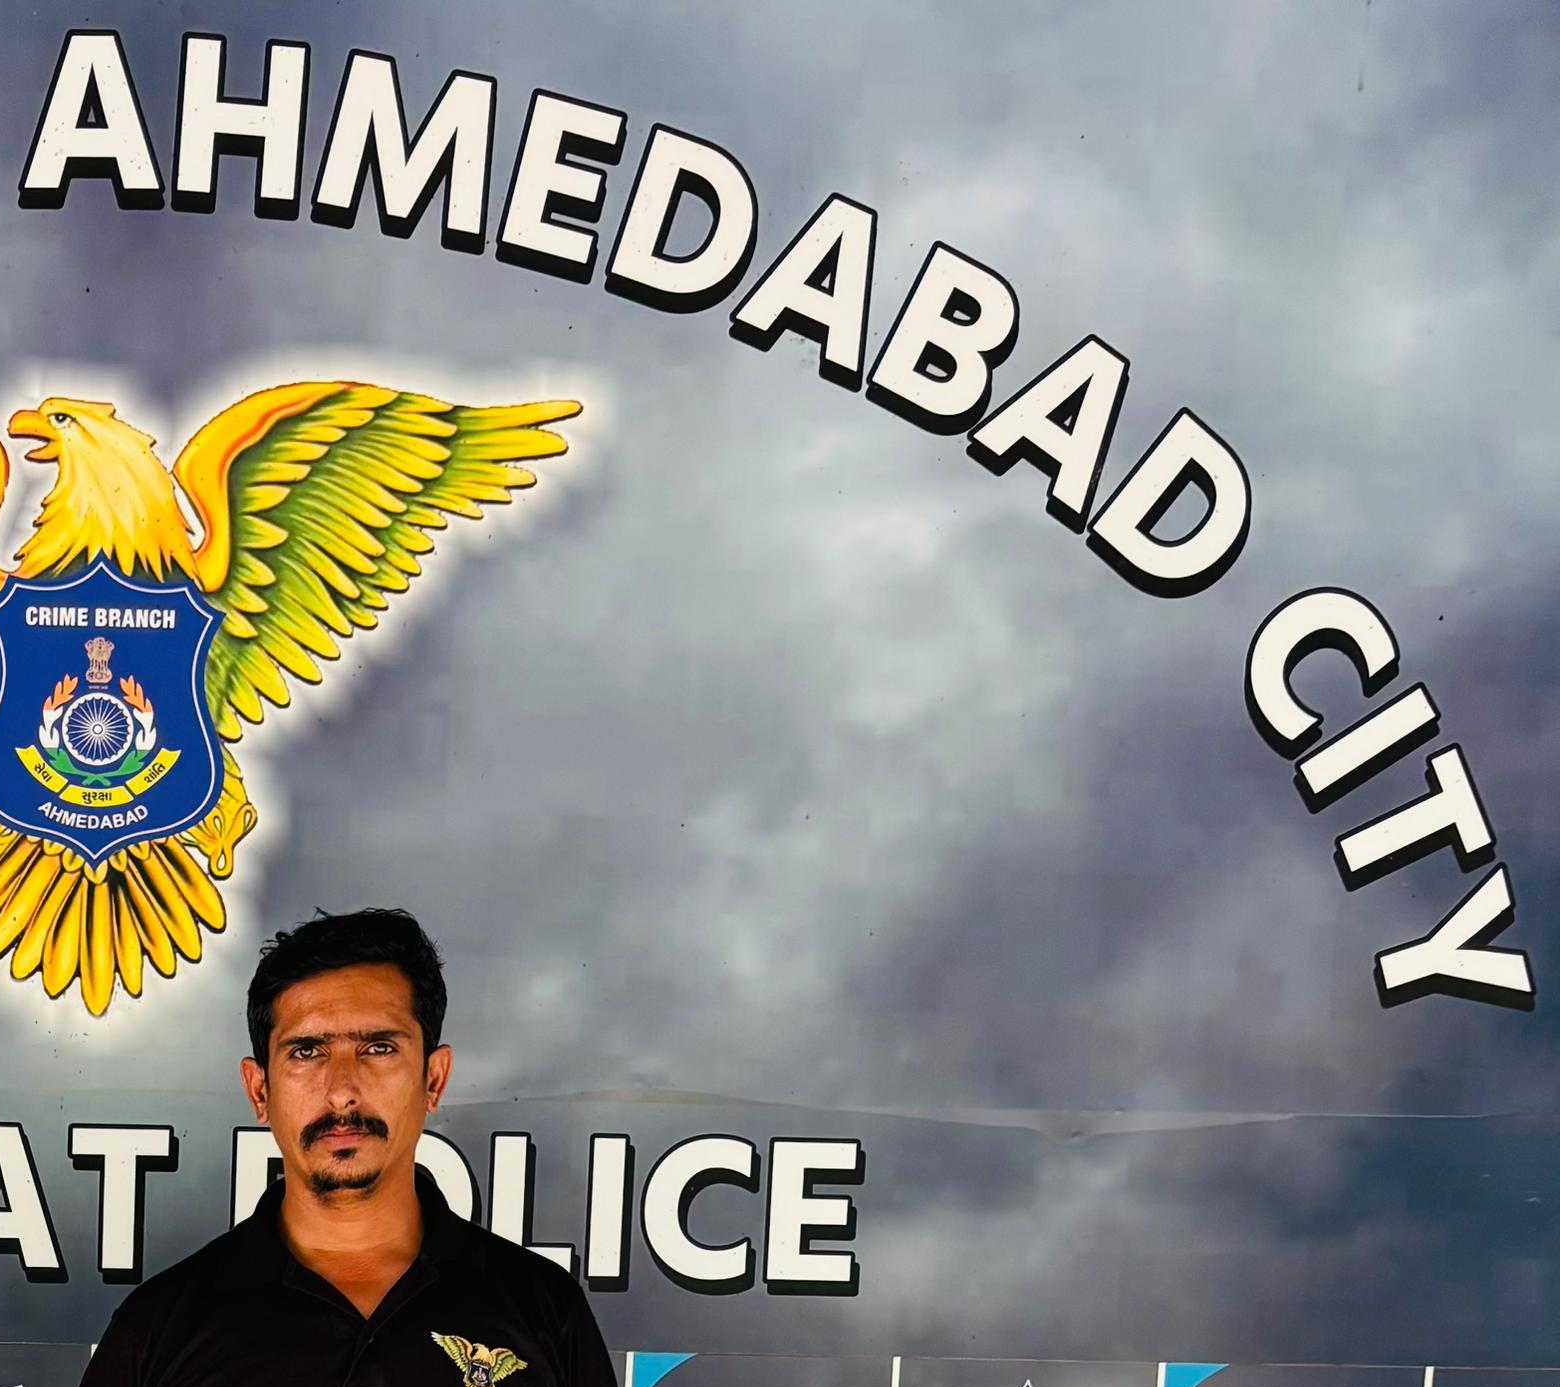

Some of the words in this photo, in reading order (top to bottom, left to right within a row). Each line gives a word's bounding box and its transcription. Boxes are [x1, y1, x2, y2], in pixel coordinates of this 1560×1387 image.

[18, 29, 1251, 592] AHMEDABAD
[1246, 587, 1536, 1004] CITY
[25, 606, 89, 628] CRIME
[94, 607, 176, 630] BRANCH
[34, 763, 52, 783] સેવા
[82, 791, 112, 804] સુરક્ષા
[144, 762, 166, 784] શાંતિ
[36, 801, 149, 829] AHMEDABAD
